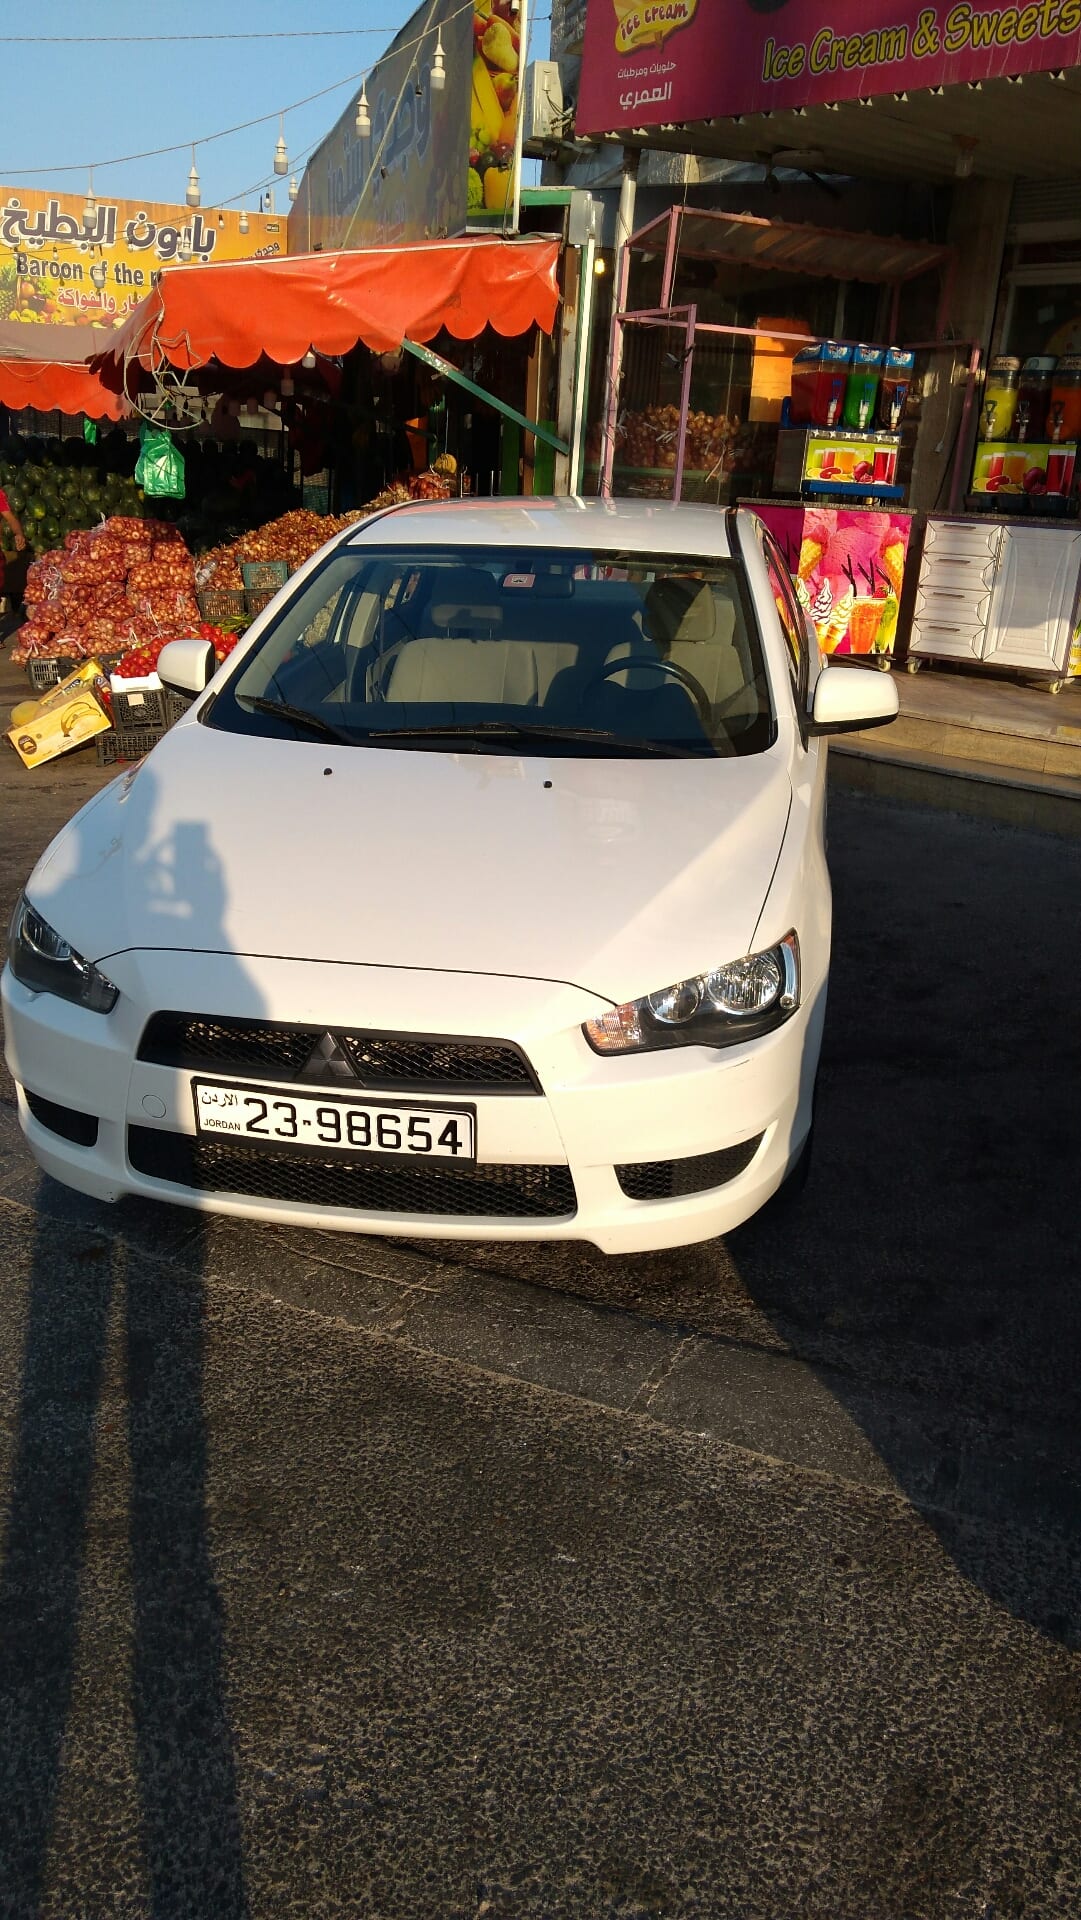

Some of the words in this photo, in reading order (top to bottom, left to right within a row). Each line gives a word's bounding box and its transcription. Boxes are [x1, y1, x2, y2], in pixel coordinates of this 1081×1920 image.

[762, 38, 805, 82] Ice
[810, 26, 907, 76] Cream
[913, 8, 939, 57] &
[944, 0, 1081, 54] Sweets
[617, 66, 648, 79] ومرطبات
[649, 61, 677, 75] حلويات
[619, 81, 673, 110] العمري
[1, 198, 118, 251] البطيخ
[16, 253, 83, 280] Baroon
[114, 262, 145, 286] the
[203, 1118, 241, 1131] JORDAN
